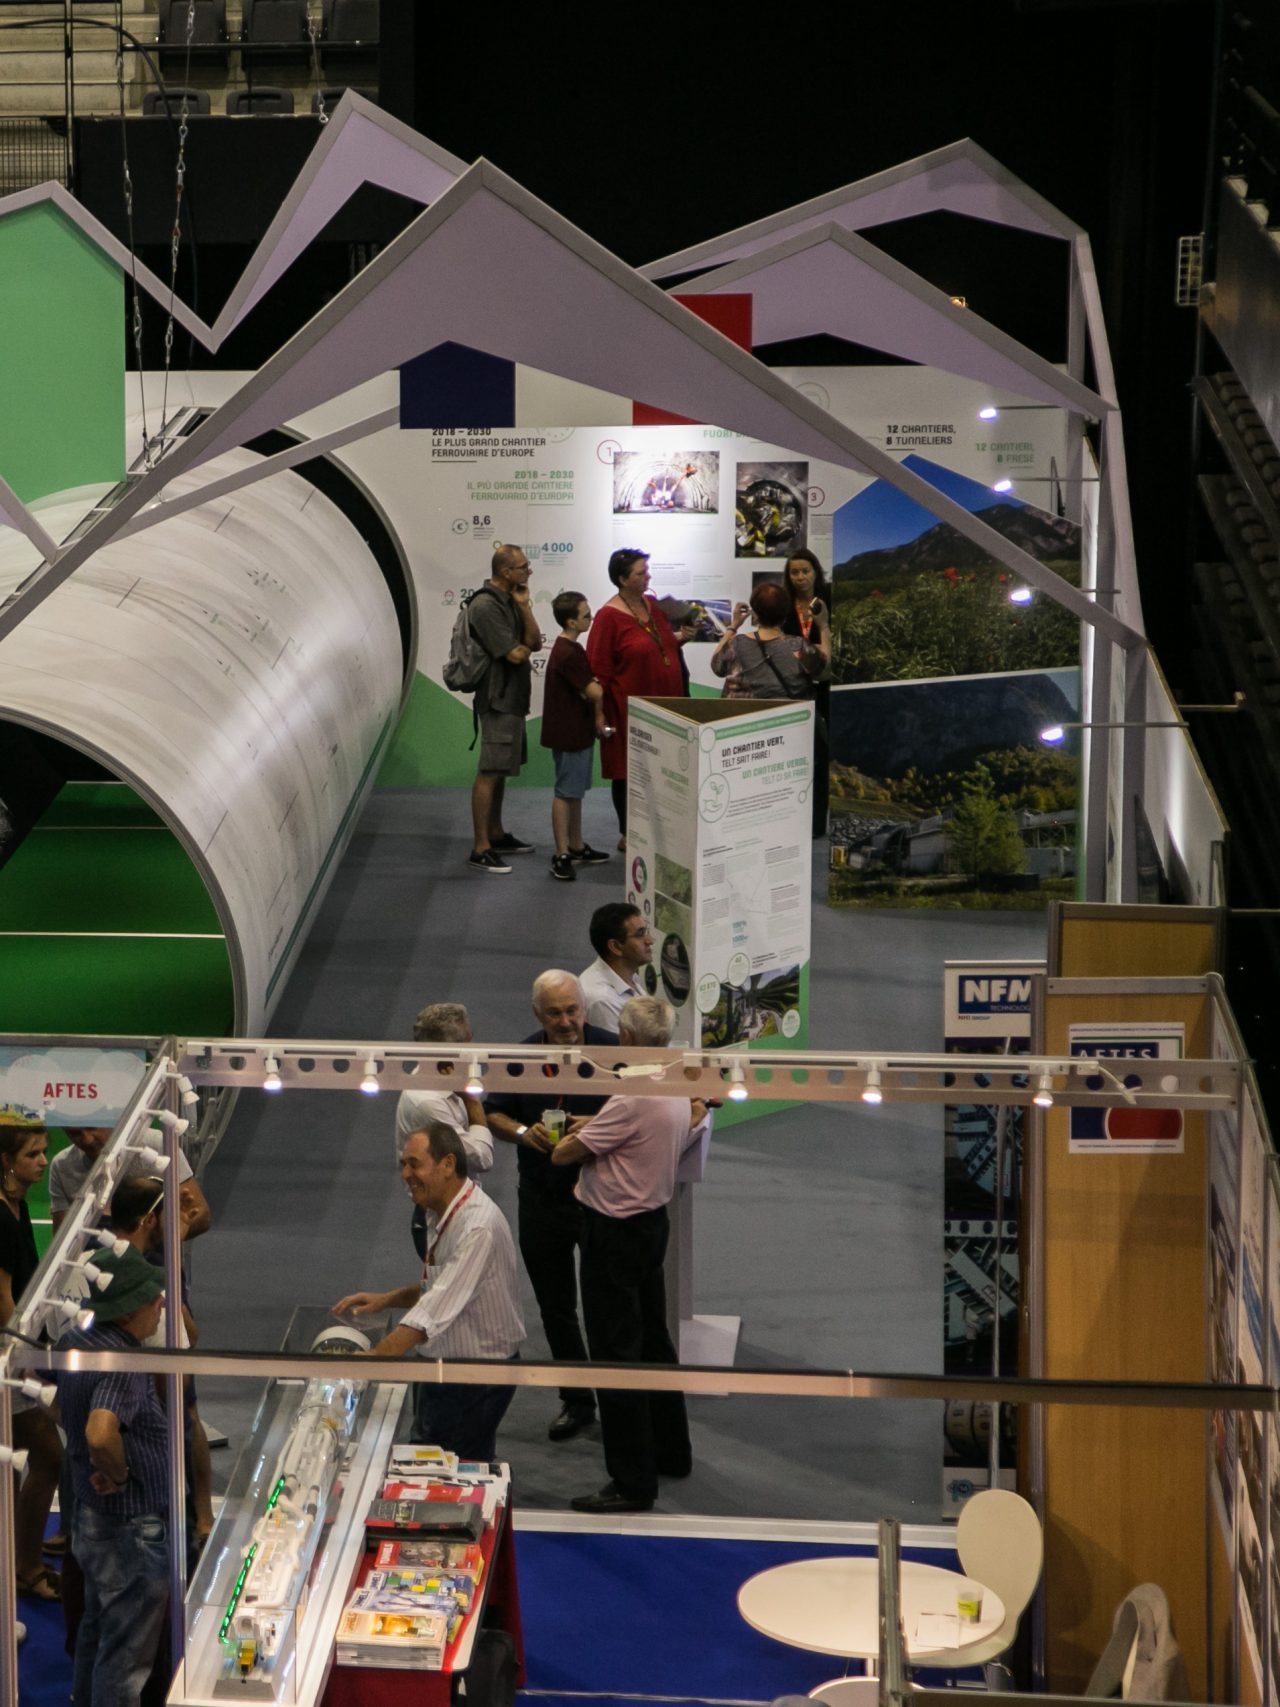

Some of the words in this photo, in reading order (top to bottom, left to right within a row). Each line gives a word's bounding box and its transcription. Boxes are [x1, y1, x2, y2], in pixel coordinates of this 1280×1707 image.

[887, 425, 898, 434] 12
[902, 424, 956, 434] CHANTIERS,
[432, 438, 442, 446] LE
[445, 437, 466, 446] PLUS
[470, 437, 499, 446] GRAND
[502, 437, 546, 446] CHANTIER
[896, 436, 952, 445] TUNNELIERS
[976, 443, 987, 451] 12
[432, 449, 489, 457] FERROVIAIRE
[492, 449, 535, 457] D'EUROPE
[514, 471, 538, 479] 2018
[549, 471, 574, 479] 2030
[467, 481, 475, 490] IL
[494, 481, 529, 490] GRANDE
[531, 481, 574, 490] CANTIERE
[471, 492, 528, 501] FERROVIARIO
[530, 492, 574, 500] D'EUROPA
[472, 515, 491, 527] 8,6
[722, 747, 731, 757] UN
[733, 740, 765, 755] CHANTIER
[767, 736, 785, 747] VERT,
[736, 754, 750, 765] SAIT
[753, 762, 784, 777] CANTIERE
[43, 1082, 98, 1099] AFTES
